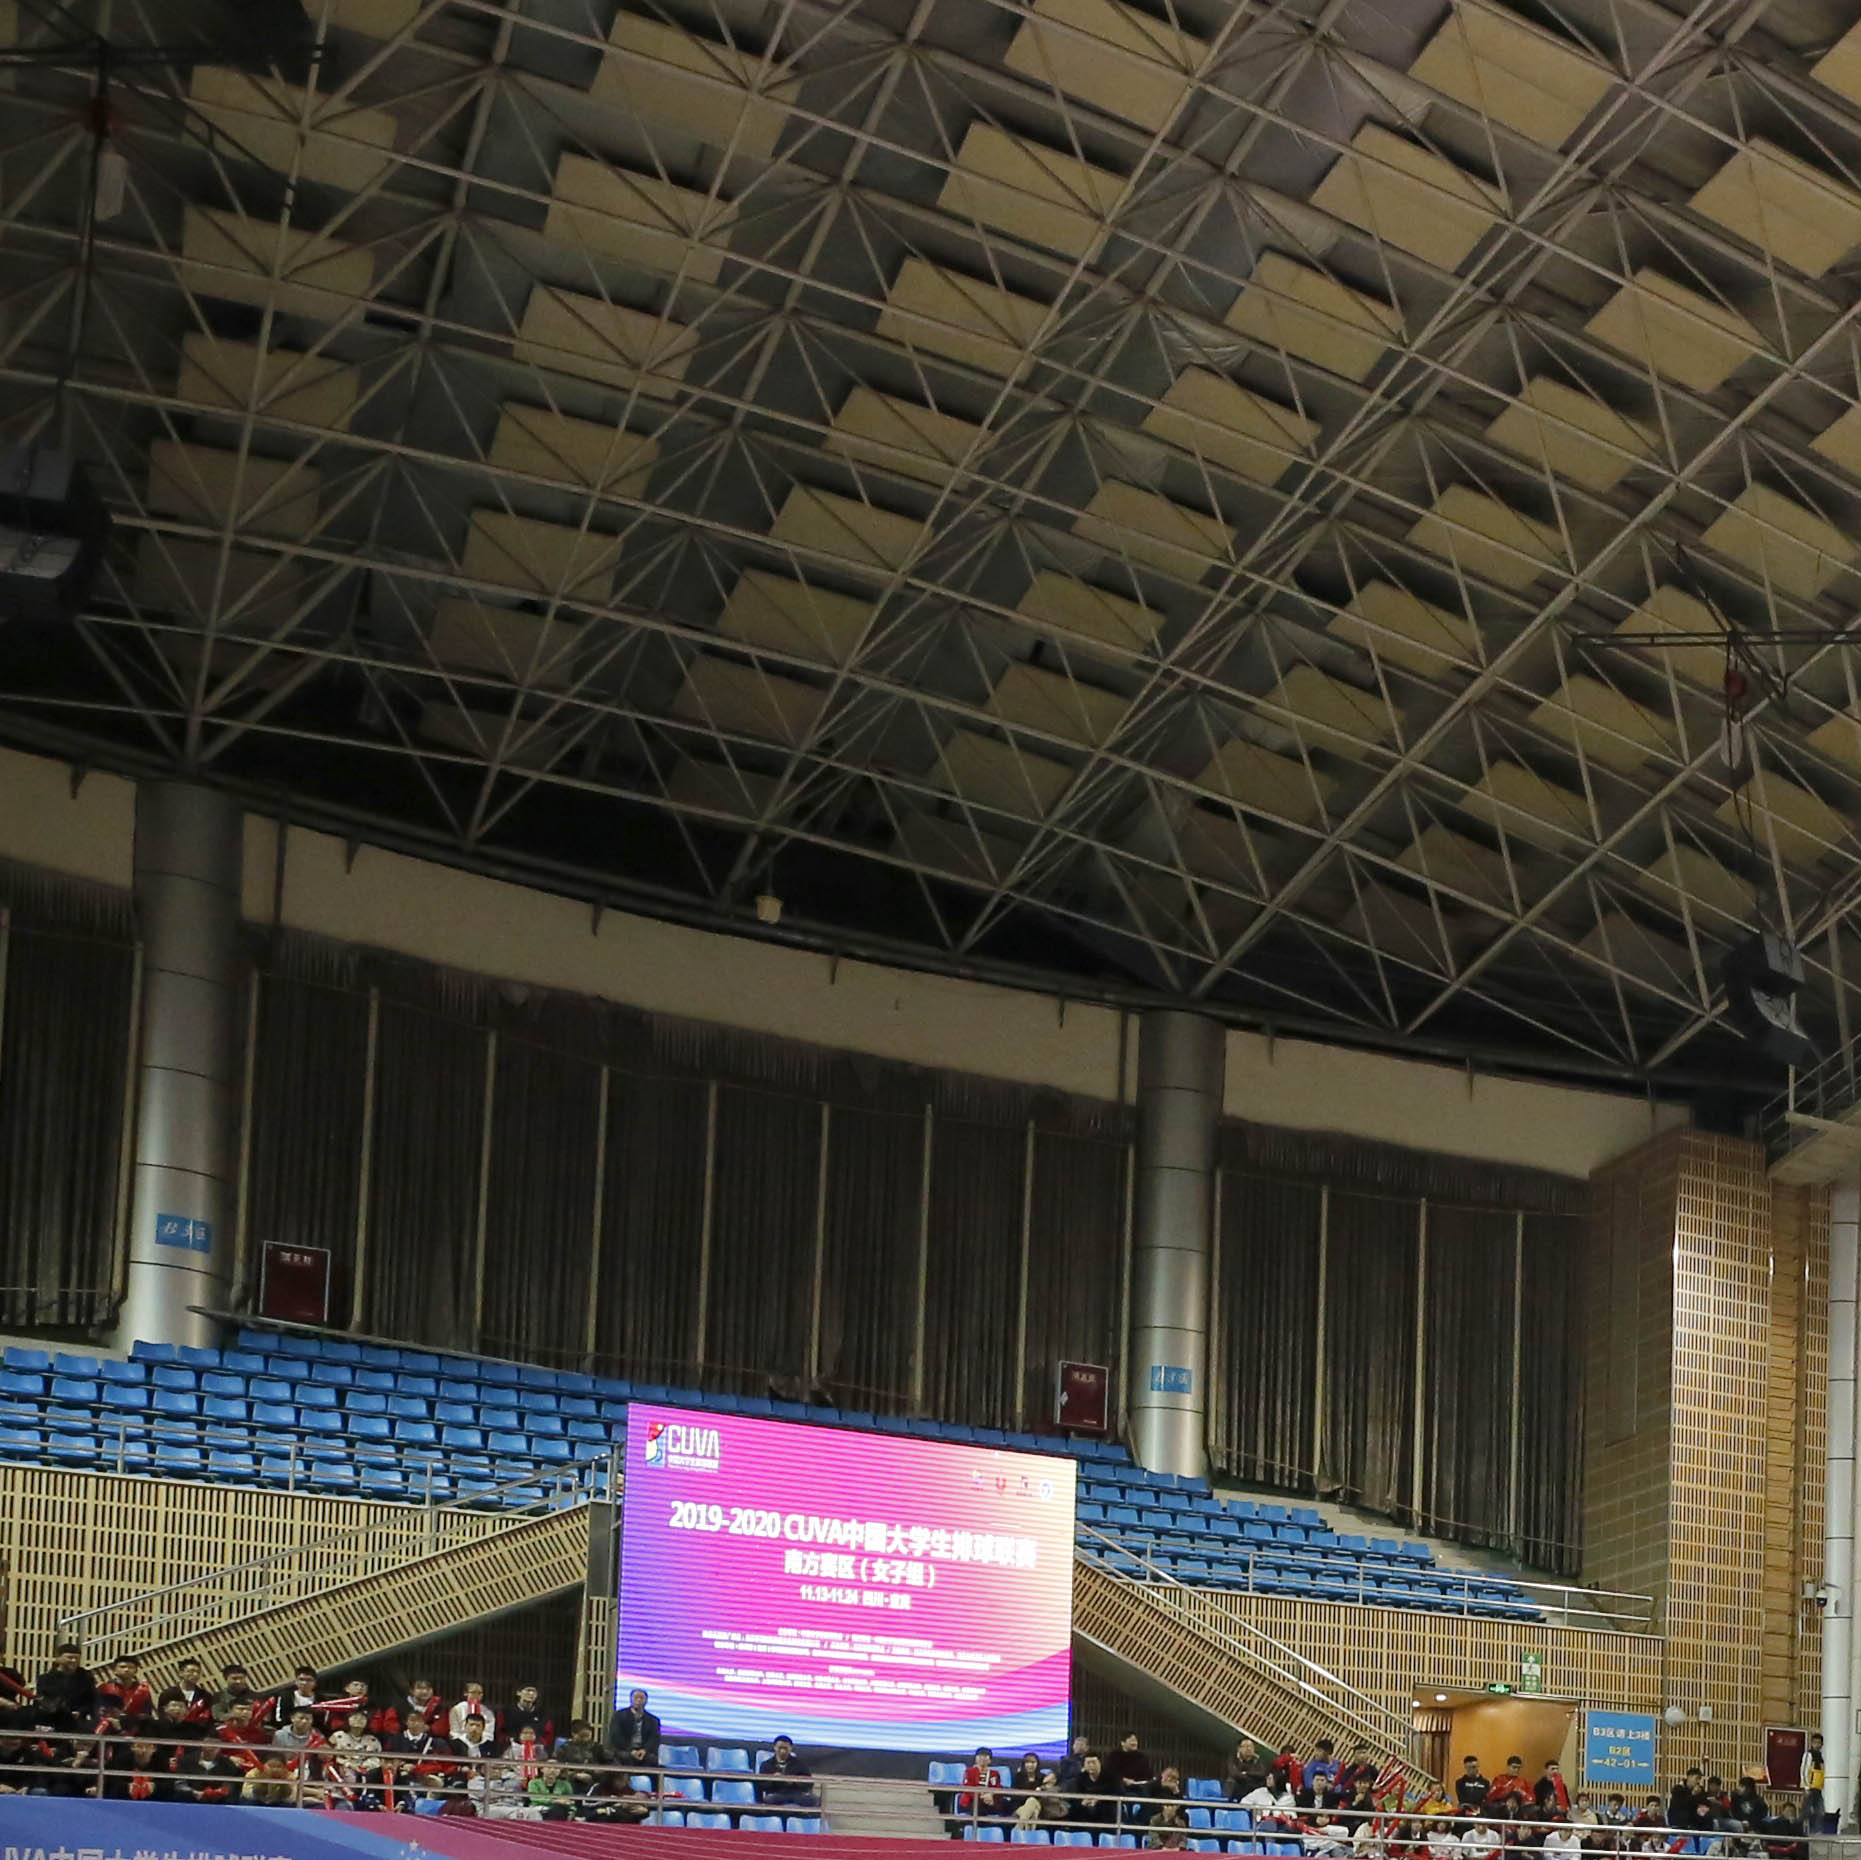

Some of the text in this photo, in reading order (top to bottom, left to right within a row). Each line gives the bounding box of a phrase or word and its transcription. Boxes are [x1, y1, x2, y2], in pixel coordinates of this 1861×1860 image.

[668, 1424, 720, 1458] CUVA
[669, 1500, 1037, 1570] 2019-2020 CUVA中国大学生排球联赛
